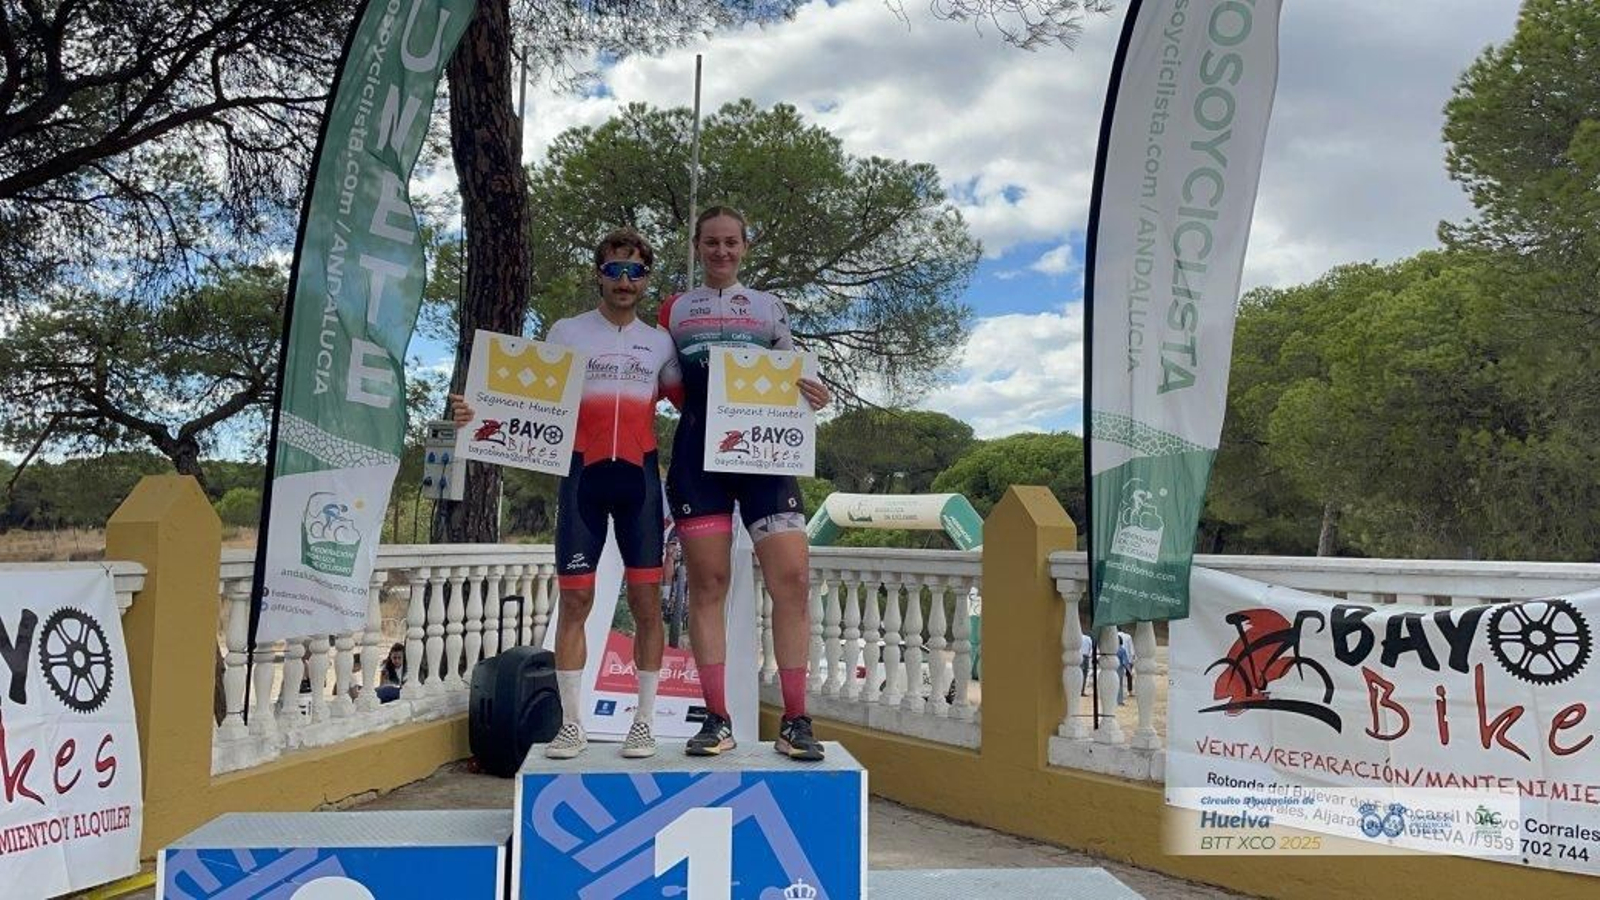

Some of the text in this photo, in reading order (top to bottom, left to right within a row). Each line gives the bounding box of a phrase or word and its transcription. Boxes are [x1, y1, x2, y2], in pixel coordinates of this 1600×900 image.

[1156, 0, 1256, 395] OSOYCICLISTA
[313, 233, 348, 395] ANDALUCIA
[476, 391, 569, 416] Segment Hunter
[717, 405, 805, 418] Segment Hunter
[507, 436, 558, 459] Bikes
[751, 444, 801, 461] Bikes
[610, 663, 638, 676] BA
[1362, 662, 1595, 761] Bike
[74, 805, 131, 838] ALQUILER
[1207, 771, 1264, 792] Rotonda
[1268, 782, 1290, 795] del
[1525, 817, 1600, 842] Corrales
[654, 806, 733, 900] 1
[1484, 834, 1514, 851] 959
[1520, 838, 1551, 857] 702
[1556, 844, 1589, 862] 744
